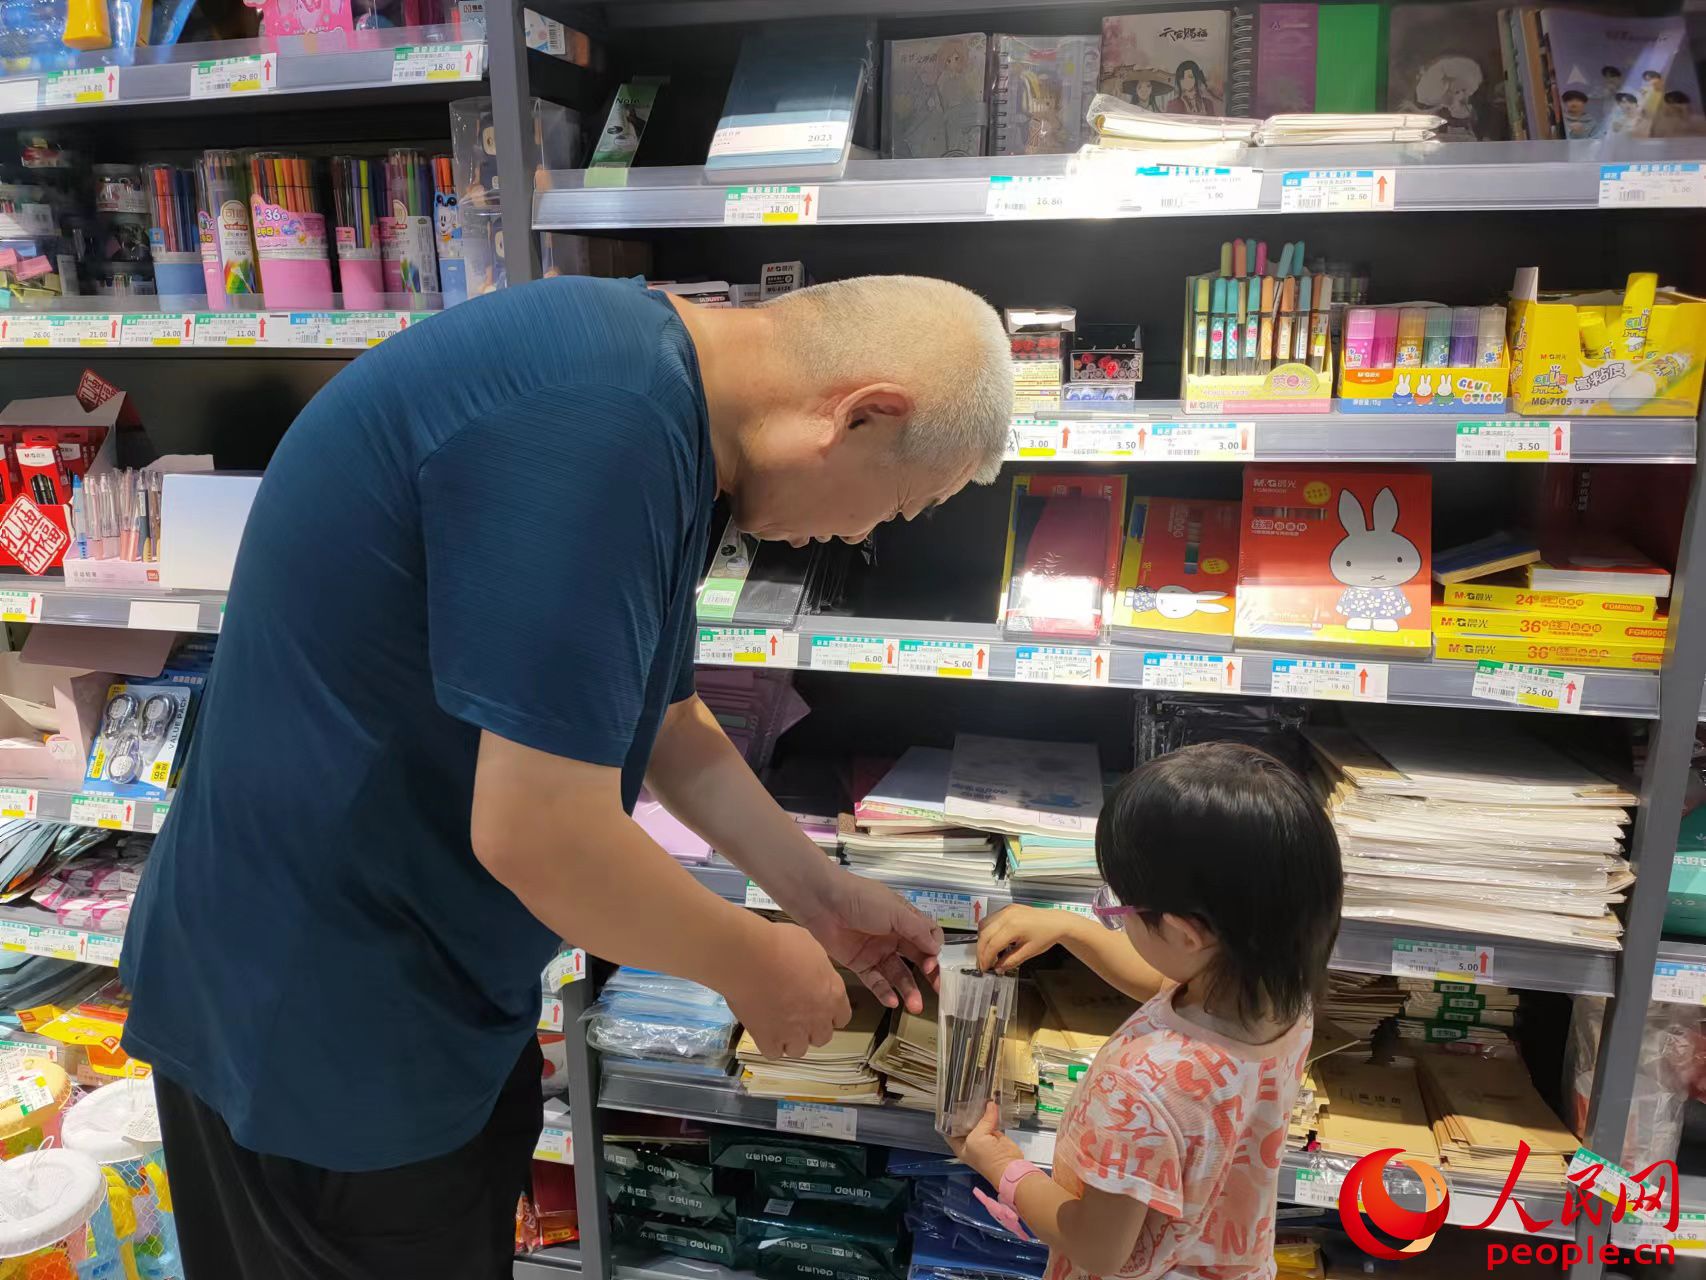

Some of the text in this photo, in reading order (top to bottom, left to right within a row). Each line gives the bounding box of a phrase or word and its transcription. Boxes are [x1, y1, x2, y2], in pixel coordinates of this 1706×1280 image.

[434, 63, 456, 71] 18.00
[238, 73, 258, 81] 29.80
[808, 134, 832, 142] 2023
[1575, 363, 1626, 390] 高粘度
[1463, 393, 1503, 403] STICK
[1532, 398, 1572, 406] MG-7105
[1030, 440, 1049, 448] 3.00
[1117, 441, 1136, 449] 3.50
[1219, 442, 1239, 450] 3.00
[1518, 442, 1540, 450] 3.50
[1455, 592, 1492, 601] M&G晨光
[1441, 617, 1488, 628] M&G晨光
[1449, 644, 1495, 655] M&G晨光
[1331, 682, 1349, 690] 19.80
[1525, 687, 1553, 698] 25.00
[169, 696, 188, 749] VALUE PACK
[1458, 963, 1478, 971] 5.00
[781, 1181, 871, 1198] 木尚 A4 deli得力
[669, 1196, 702, 1208] deli得力
[690, 1241, 724, 1254] deli得力
